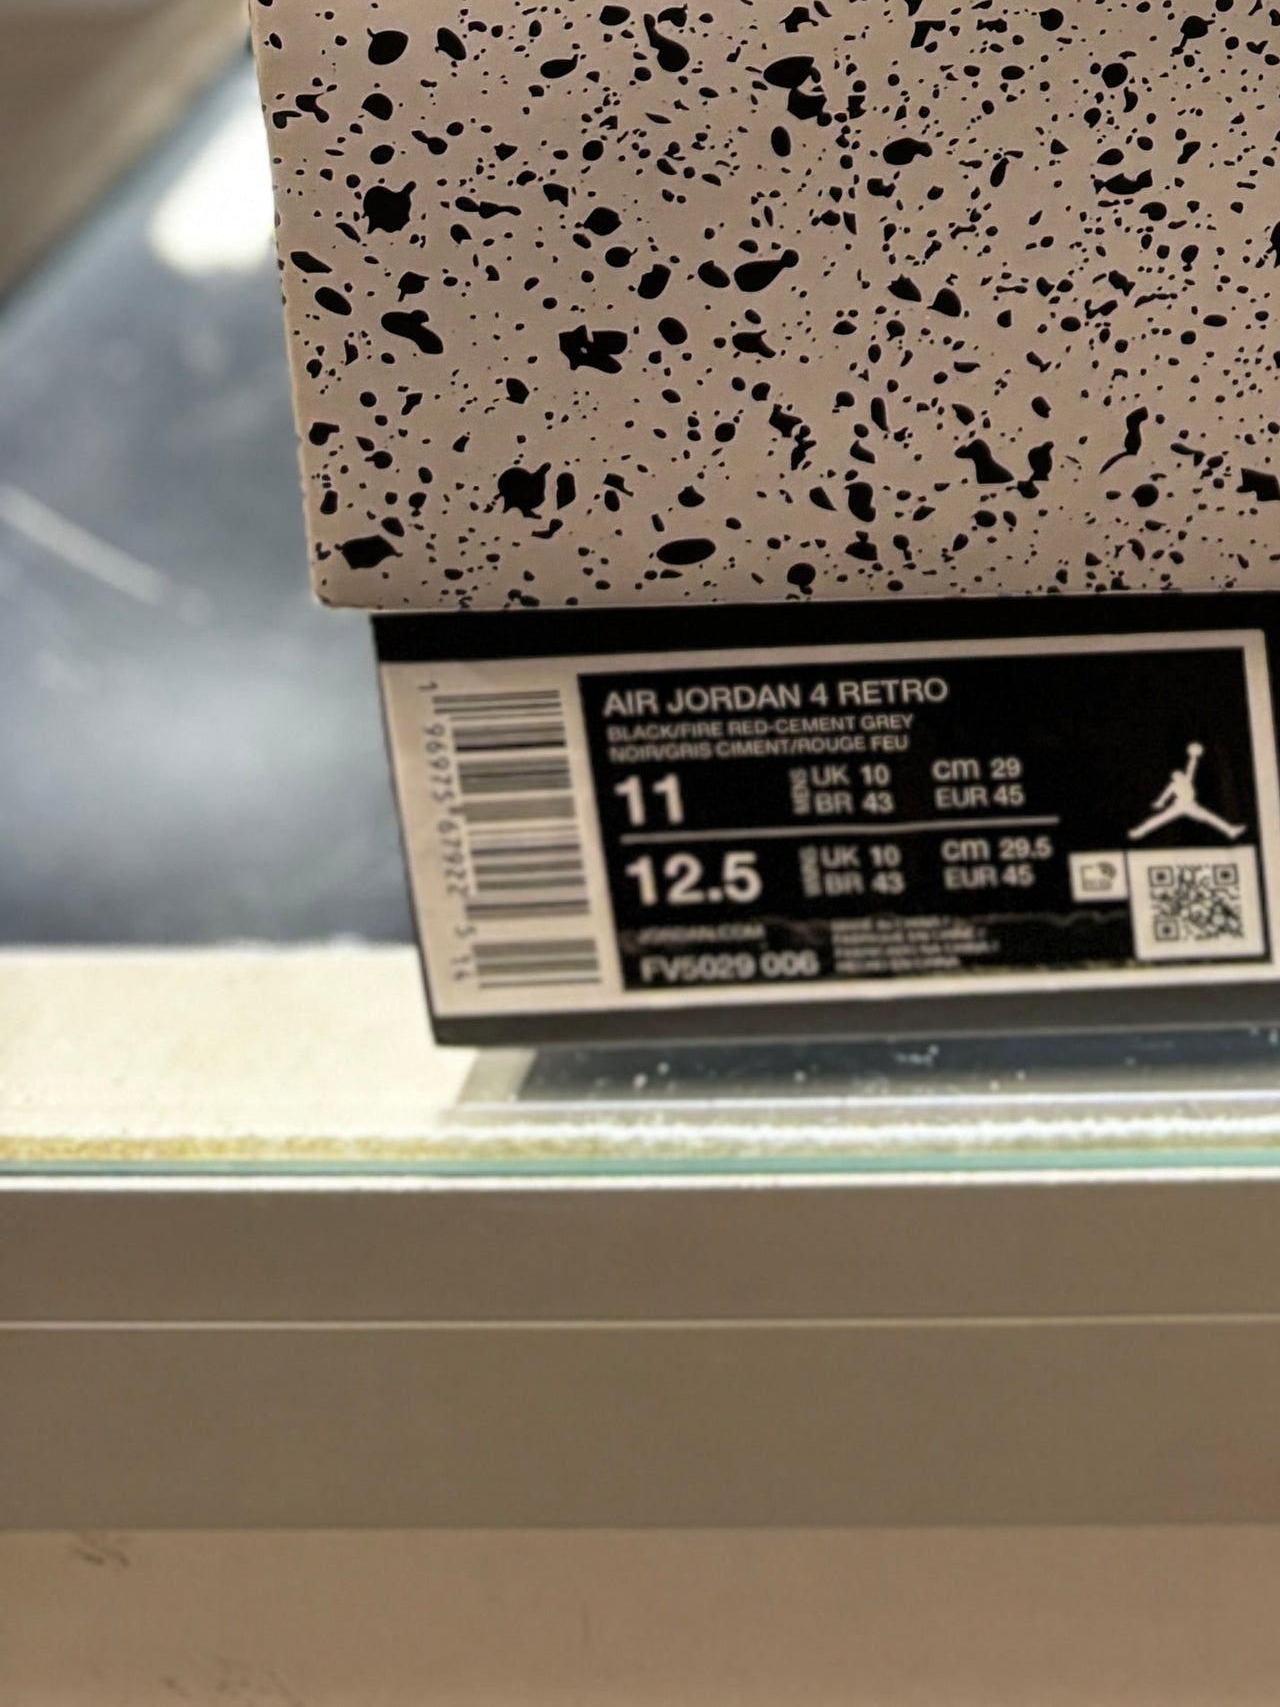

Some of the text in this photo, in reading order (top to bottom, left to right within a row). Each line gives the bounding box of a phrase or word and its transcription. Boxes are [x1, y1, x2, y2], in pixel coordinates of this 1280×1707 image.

[603, 677, 949, 718] AIR JORDAN 4 RETRO
[606, 713, 914, 744] BLACK/FIRE RED-CEMENT GREY
[608, 734, 909, 764] NOIR/GRIS CIMENT/ROUGE FEU
[811, 763, 891, 786] UK 10
[990, 756, 1022, 779] 29
[613, 772, 685, 826] 11
[814, 791, 895, 815] BR 43
[934, 785, 1026, 809] EUR 45
[819, 844, 902, 868] UK 10
[998, 837, 1054, 860] 29.5
[624, 850, 763, 906] 12.5
[823, 871, 865, 896] BR
[869, 871, 906, 895] 43
[943, 863, 1036, 889] EUR 45
[640, 952, 757, 983] FV5029
